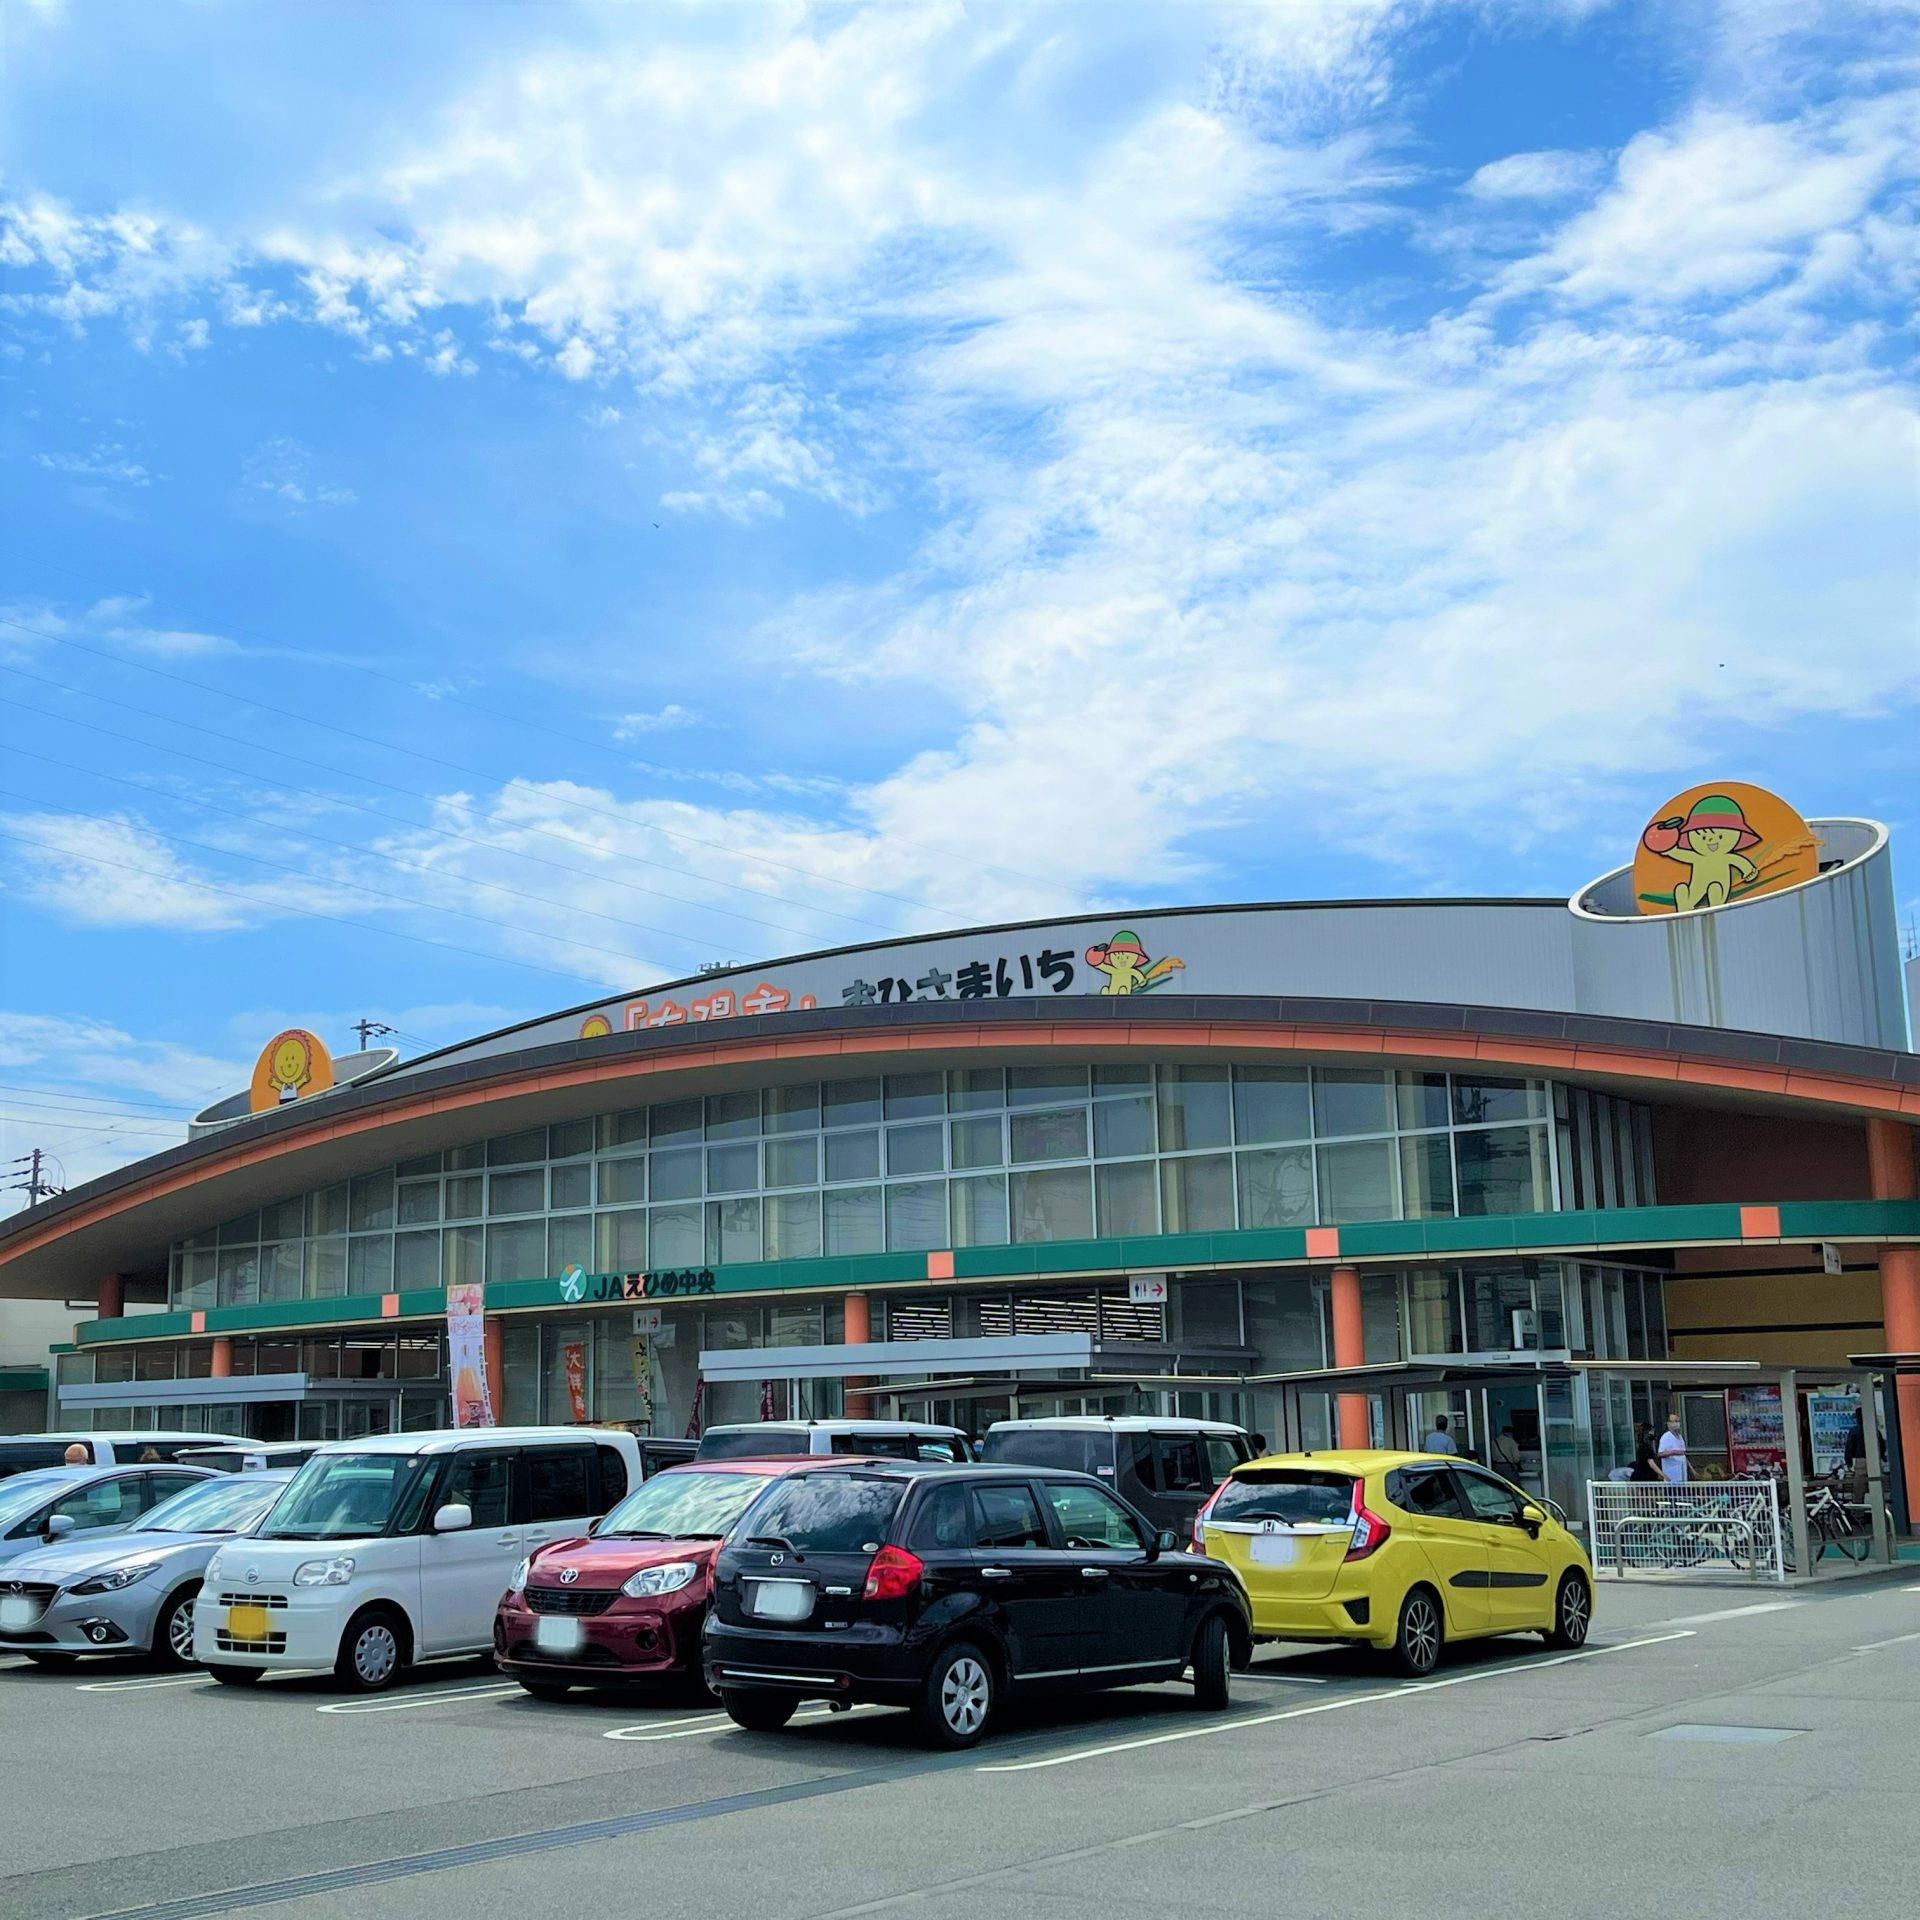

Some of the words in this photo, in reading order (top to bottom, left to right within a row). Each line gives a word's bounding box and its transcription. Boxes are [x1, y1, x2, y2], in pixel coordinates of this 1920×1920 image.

[842, 950, 1075, 1007] おひさまいち
[594, 1268, 715, 1299] JAえひめ中央
